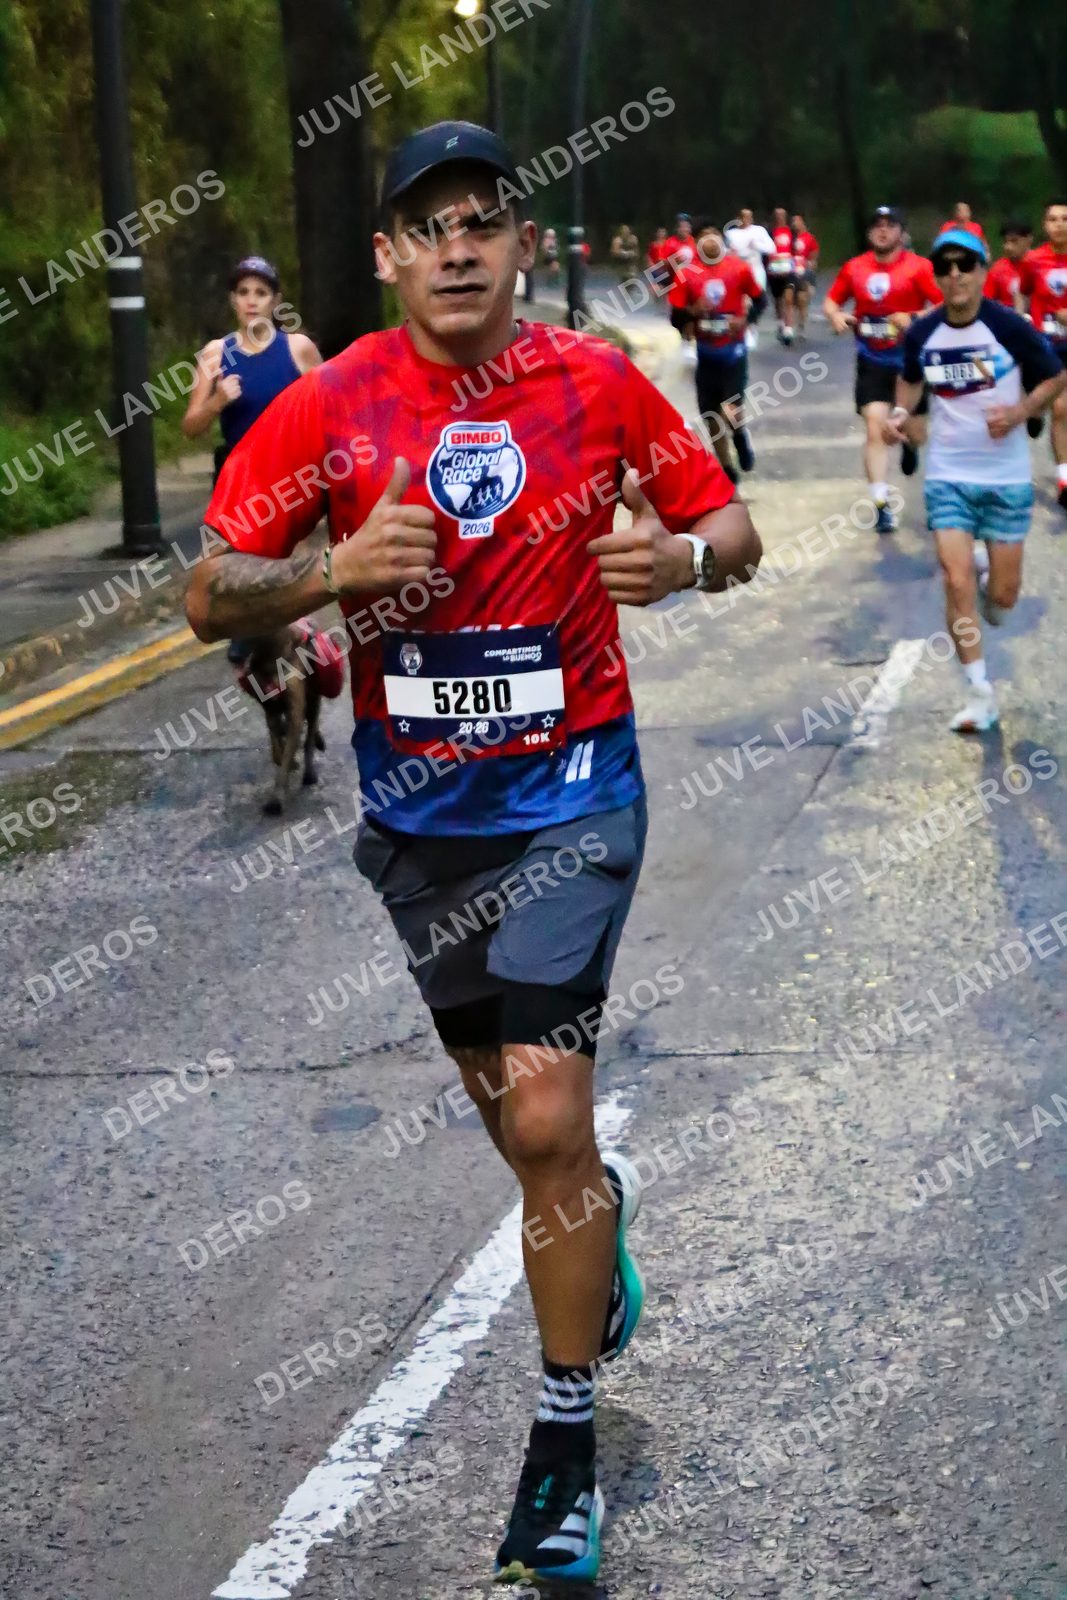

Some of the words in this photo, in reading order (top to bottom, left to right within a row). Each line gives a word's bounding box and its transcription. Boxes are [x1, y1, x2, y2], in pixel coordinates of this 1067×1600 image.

[450, 431, 502, 444] BIMBO
[452, 449, 501, 469] Global
[441, 467, 483, 485] Race
[462, 522, 491, 536] 2026
[432, 678, 513, 715] 5280
[522, 731, 550, 746] 10K
